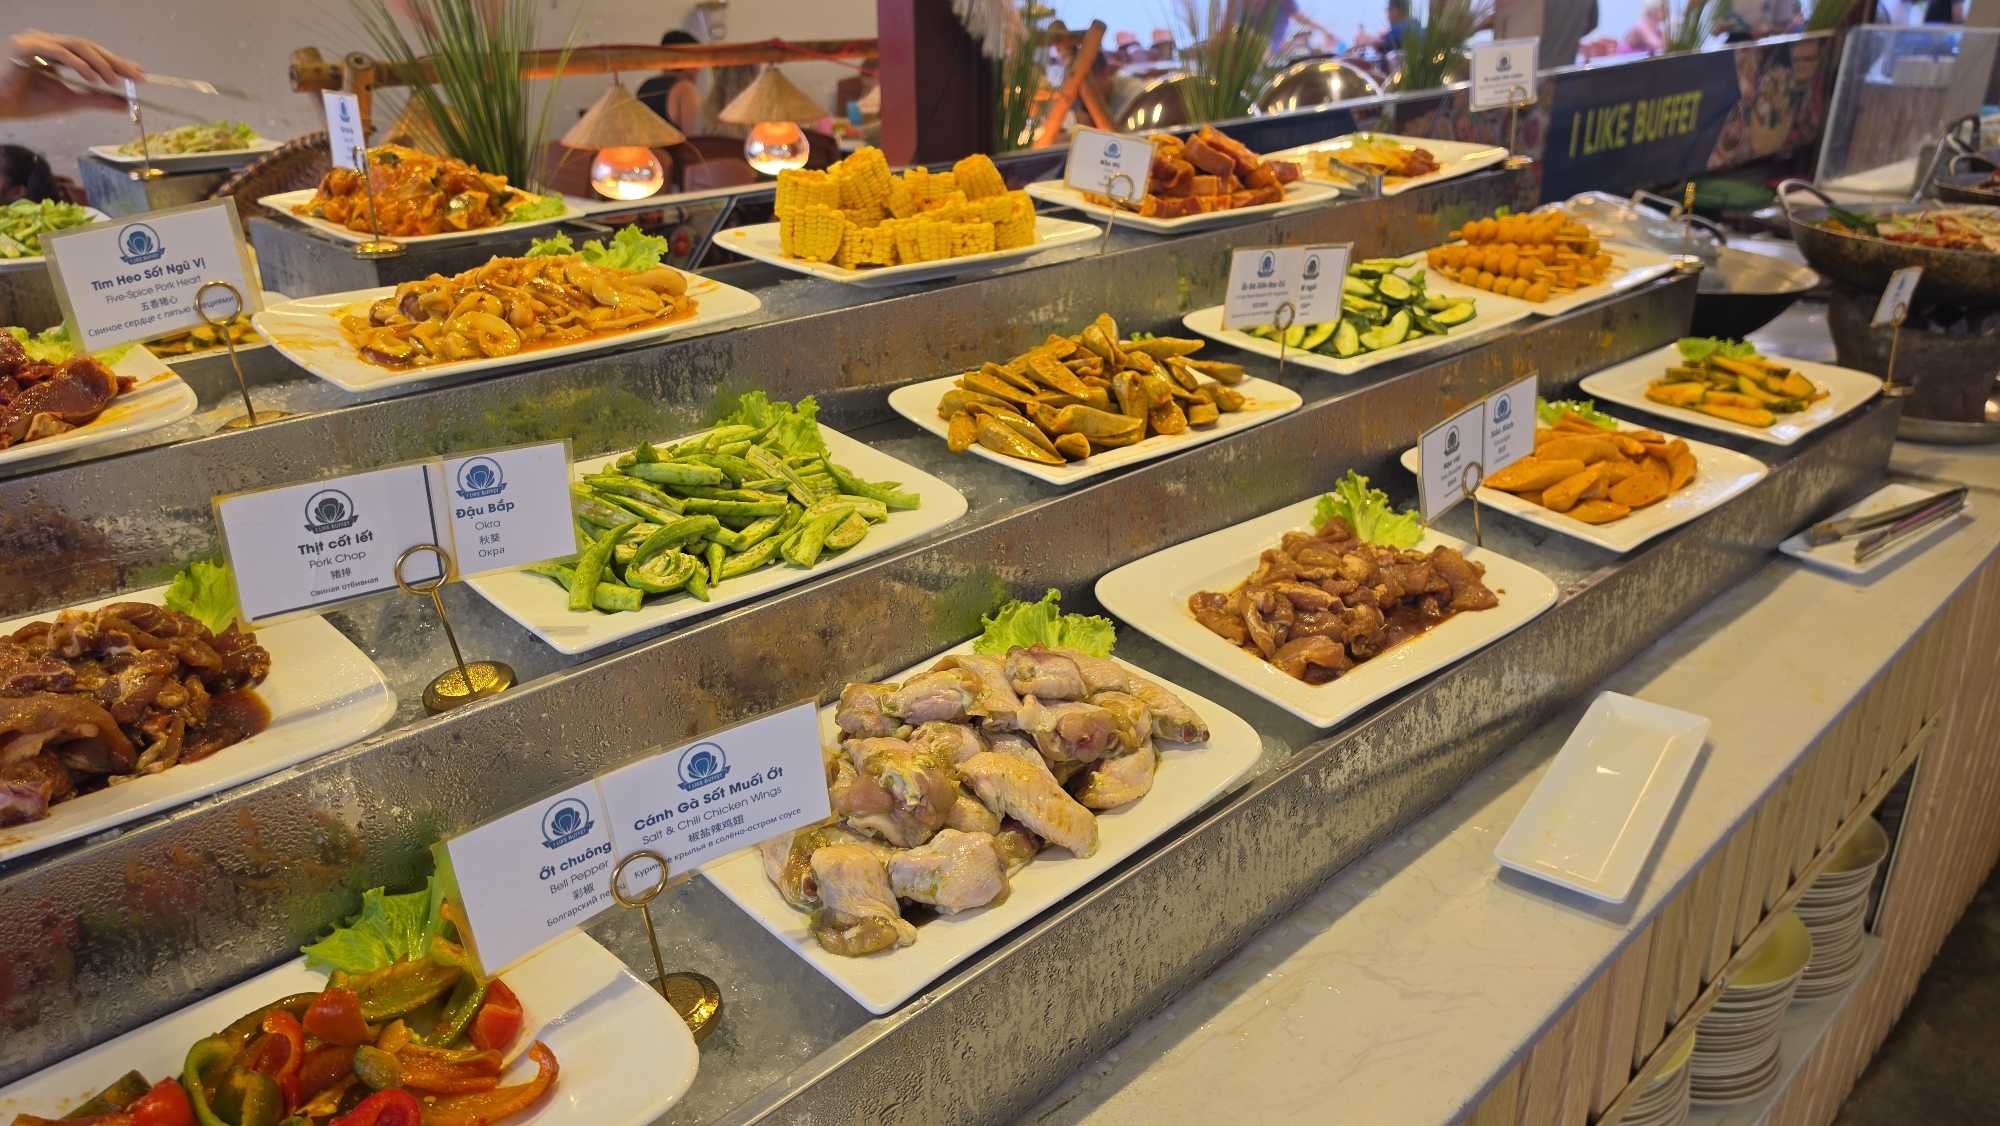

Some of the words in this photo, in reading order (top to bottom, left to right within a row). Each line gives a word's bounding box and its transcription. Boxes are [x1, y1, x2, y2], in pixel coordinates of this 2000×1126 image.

[1569, 111, 1581, 158] I
[1583, 102, 1632, 156] LIKE
[1632, 89, 1704, 145] BUFFET
[143, 253, 159, 261] BUFFET
[91, 280, 114, 291] Tim
[116, 274, 142, 286] Heo
[144, 265, 163, 279] Sốt
[166, 260, 191, 275] Ngũ
[192, 257, 207, 269] Vị
[105, 287, 154, 304] Five-Spice
[155, 281, 175, 293] Pork
[176, 275, 202, 287] Heart
[140, 295, 179, 311] 五香猪心
[88, 324, 123, 337] Свиное
[124, 314, 156, 329] сердце
[164, 306, 191, 319] пятью
[193, 295, 235, 312] сециями
[481, 488, 499, 496] BUFFET
[456, 506, 484, 519] Đậu
[488, 499, 515, 513] Bắp
[318, 524, 330, 532] LIKE
[331, 521, 350, 529] BUFFET
[475, 520, 501, 530] Okra
[298, 541, 324, 555] Thịt
[328, 533, 351, 549] cốt
[355, 529, 373, 544] lết
[479, 533, 501, 545] 秋葵
[309, 557, 333, 569] Pork
[335, 551, 366, 563] Chop
[478, 547, 505, 557] Окра
[330, 567, 352, 580] 猪排
[310, 585, 340, 597] Свиная
[341, 577, 379, 590] отбивная
[692, 780, 703, 788] LIKE
[704, 773, 723, 783] BUFFET
[634, 809, 674, 831] Cánh
[677, 798, 700, 814] Gà
[703, 786, 726, 804] Sốt
[729, 772, 764, 795] Muối
[767, 766, 784, 780] Ớt
[642, 829, 663, 845] Salt
[666, 825, 676, 836] &
[677, 814, 702, 831] Chili
[703, 799, 749, 821] Chicken
[750, 786, 783, 803] Wings
[556, 836, 568, 846] LIKE
[568, 828, 587, 841] BUFFET
[674, 842, 707, 861] крылья
[708, 840, 714, 848] в
[715, 816, 778, 844] солёно-остром
[779, 807, 802, 821] соусе
[688, 813, 745, 844] 椒盐辣鸡翅
[539, 865, 556, 880] Ớt
[559, 841, 612, 871] chuông
[549, 879, 569, 895] Bell
[570, 860, 609, 884] Pepper
[572, 882, 596, 901] 彩椒
[546, 895, 599, 927] Болгарский
